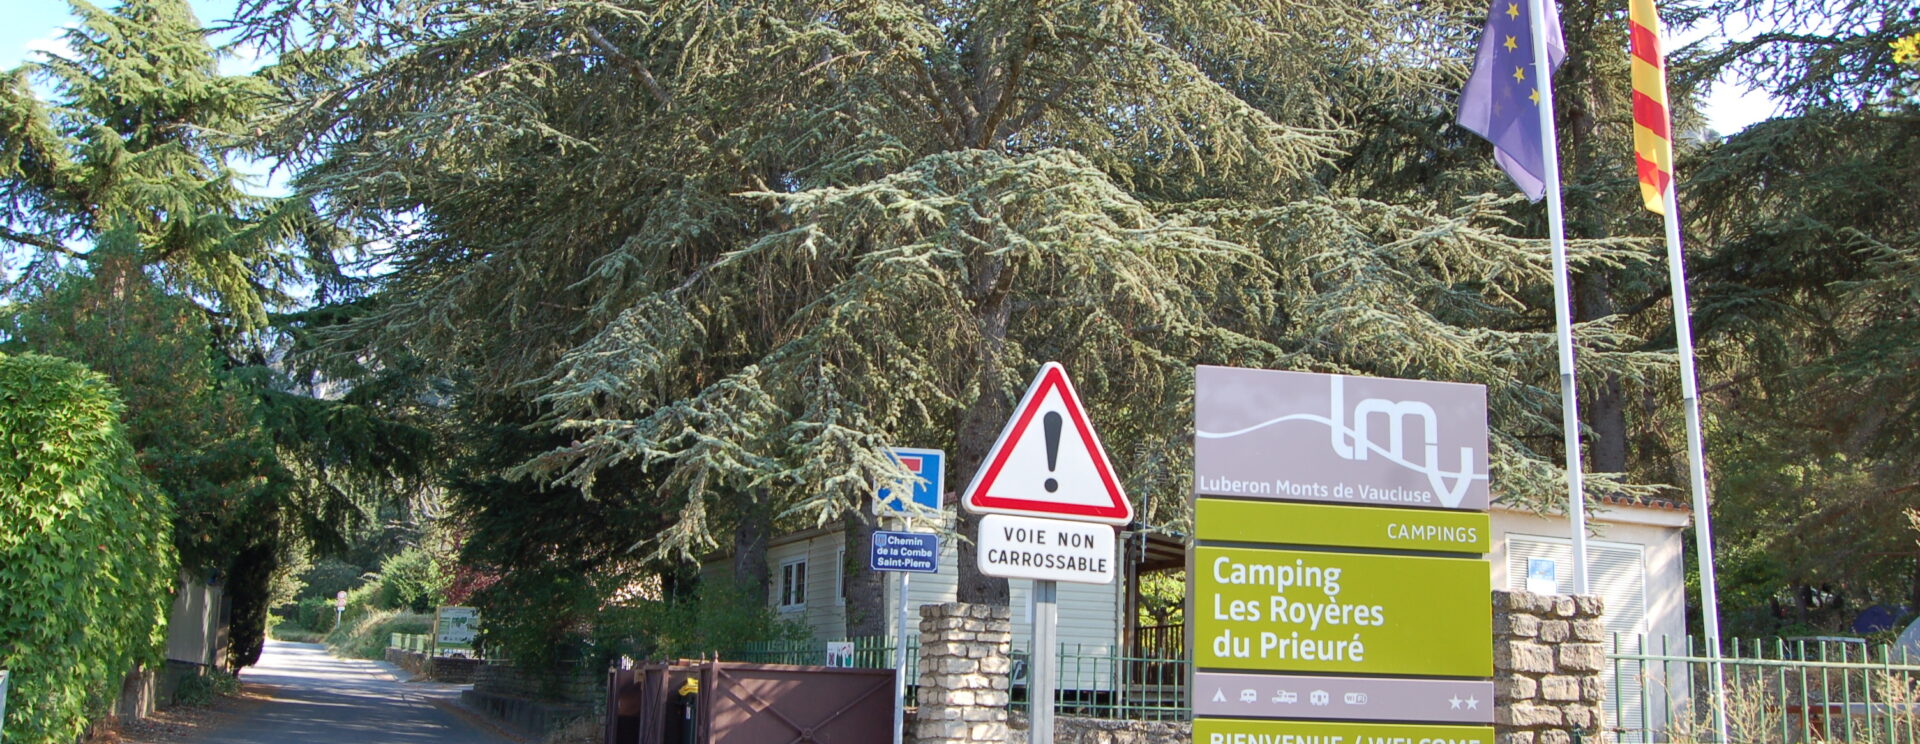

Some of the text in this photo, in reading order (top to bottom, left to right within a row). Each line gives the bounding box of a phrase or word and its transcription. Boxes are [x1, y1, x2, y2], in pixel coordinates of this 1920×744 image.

[1200, 476, 1431, 503] Luberon Monts de Vaucluse
[888, 536, 923, 546] Chemin
[1004, 527, 1094, 549] VOIE NON
[1387, 523, 1478, 543] CAMPINGS
[877, 547, 933, 557] de la Combe
[877, 557, 931, 568] Saint-Pierre
[988, 549, 1107, 573] CARROSSABLE
[1213, 556, 1342, 596] Camping
[1214, 593, 1384, 631] Les Royères
[1213, 629, 1365, 662] du Prieuré
